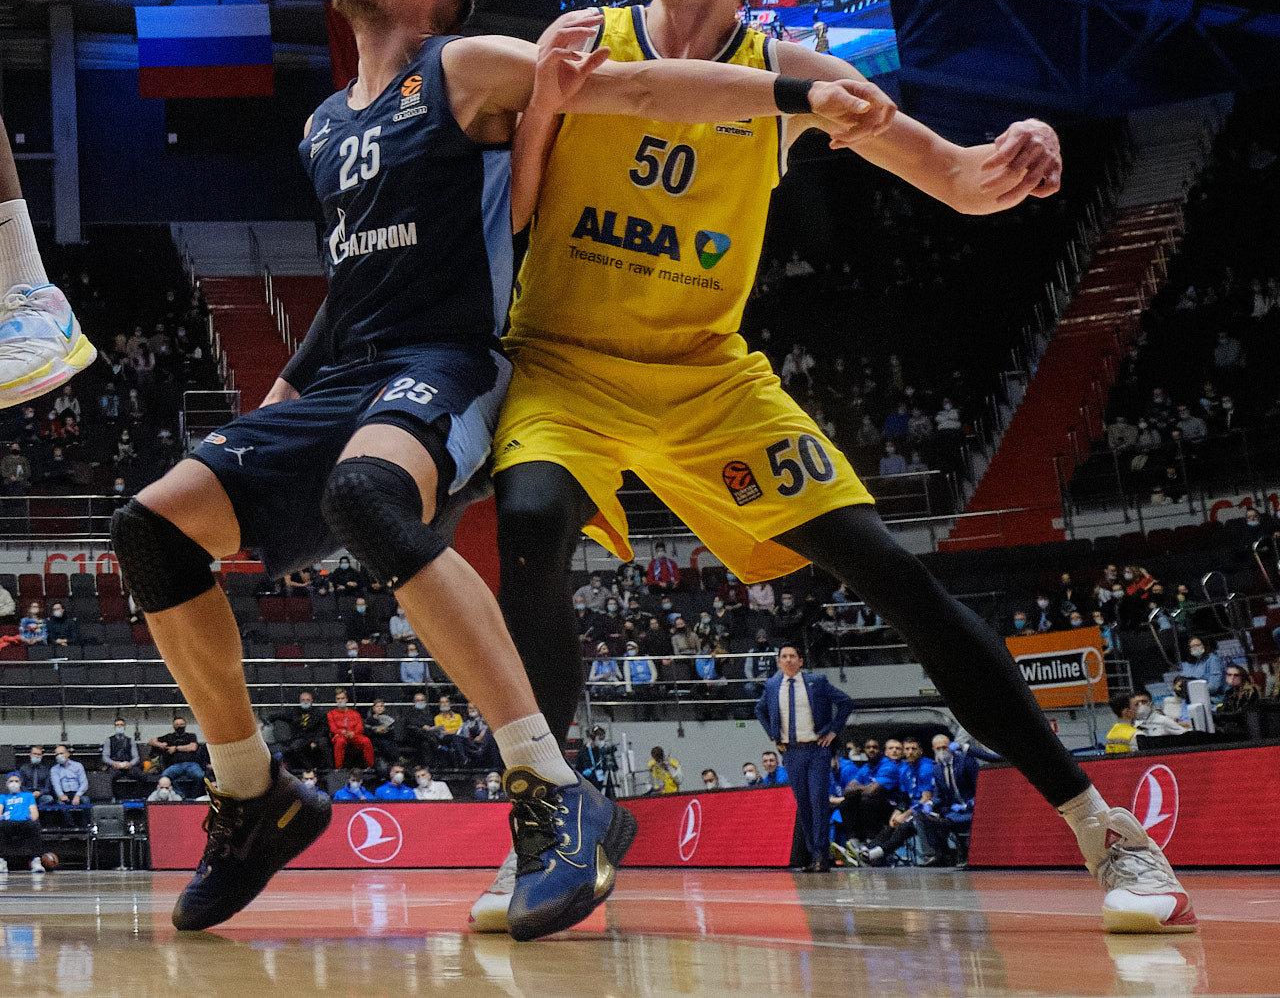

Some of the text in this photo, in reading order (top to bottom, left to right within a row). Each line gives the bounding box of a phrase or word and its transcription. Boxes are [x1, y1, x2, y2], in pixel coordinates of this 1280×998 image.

[339, 125, 382, 191] 25
[629, 134, 697, 197] 50
[572, 206, 680, 262] ALBA
[569, 245, 724, 291] Treasure raw materials.
[383, 377, 438, 405] 25
[766, 433, 835, 497] 50
[1020, 660, 1081, 682] Winline
